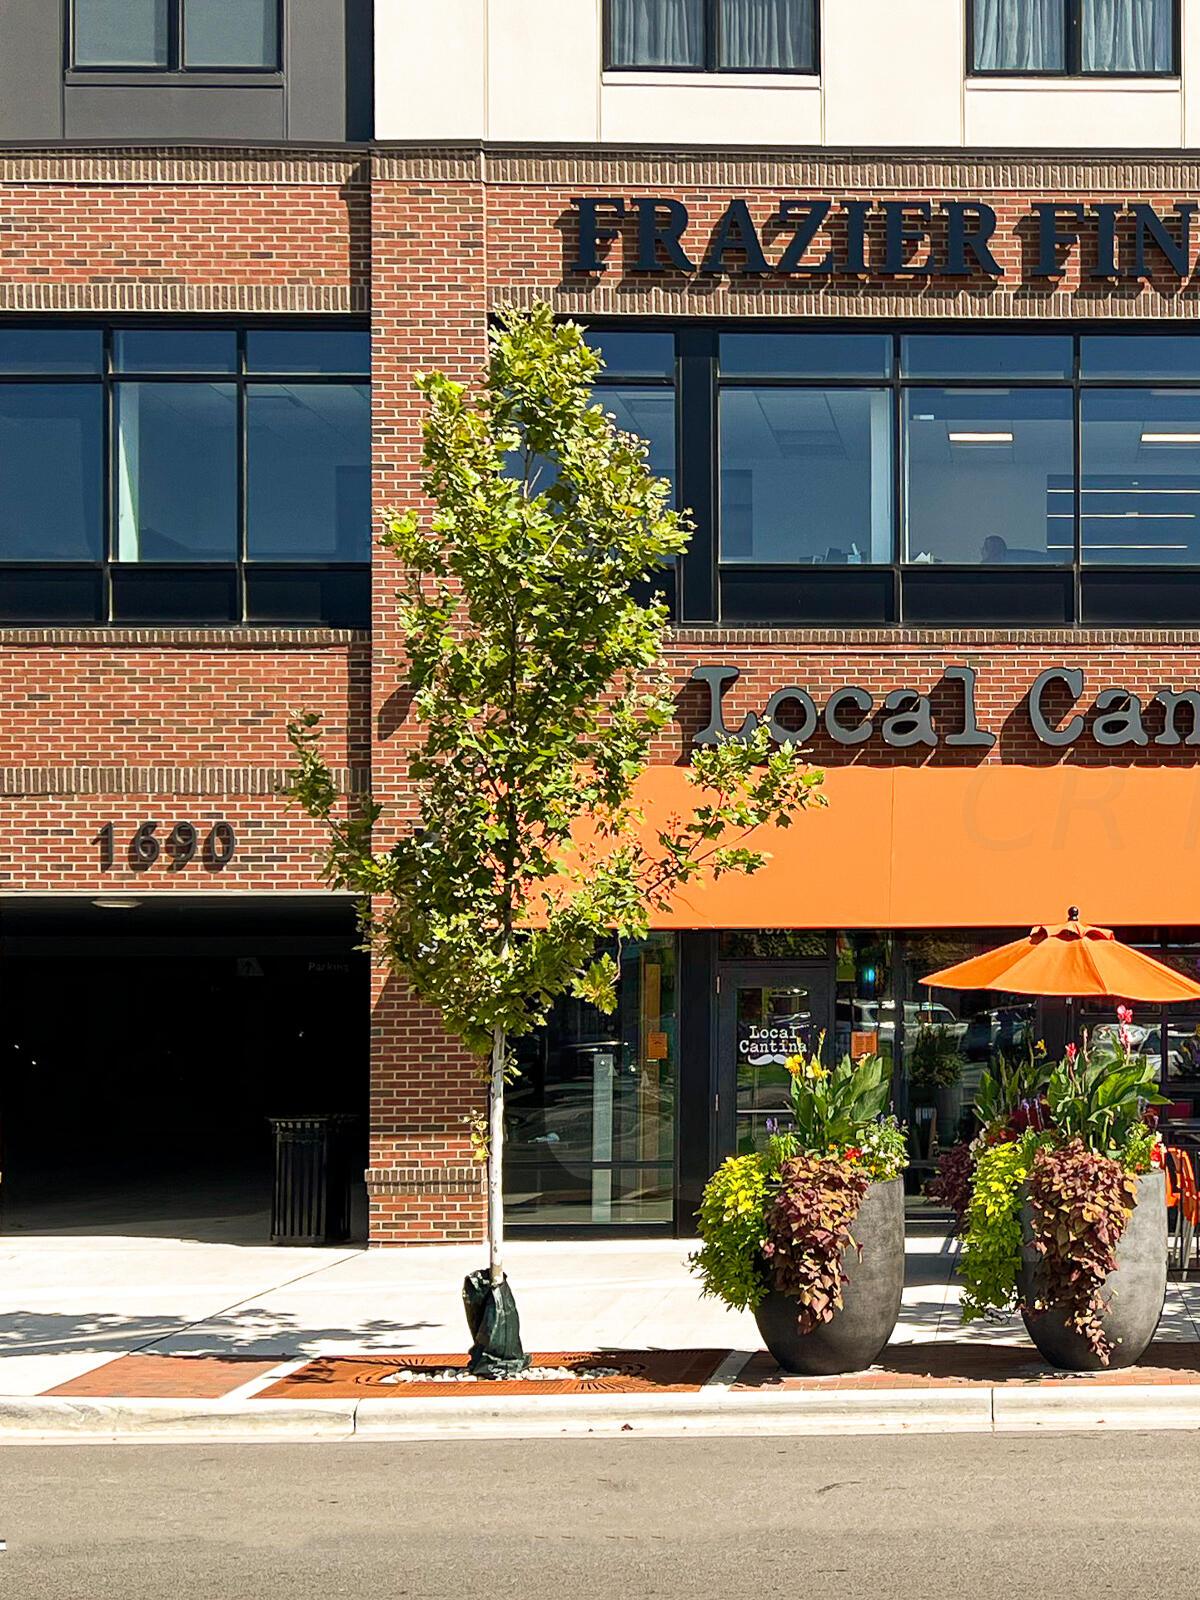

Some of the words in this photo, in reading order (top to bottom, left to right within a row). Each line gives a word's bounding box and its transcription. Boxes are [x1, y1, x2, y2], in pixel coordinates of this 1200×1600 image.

[569, 197, 1004, 276] FRAZIER
[691, 665, 997, 747] Local
[90, 821, 236, 873] 1690
[739, 1040, 808, 1053] Cantina
[749, 1025, 797, 1039] Local
